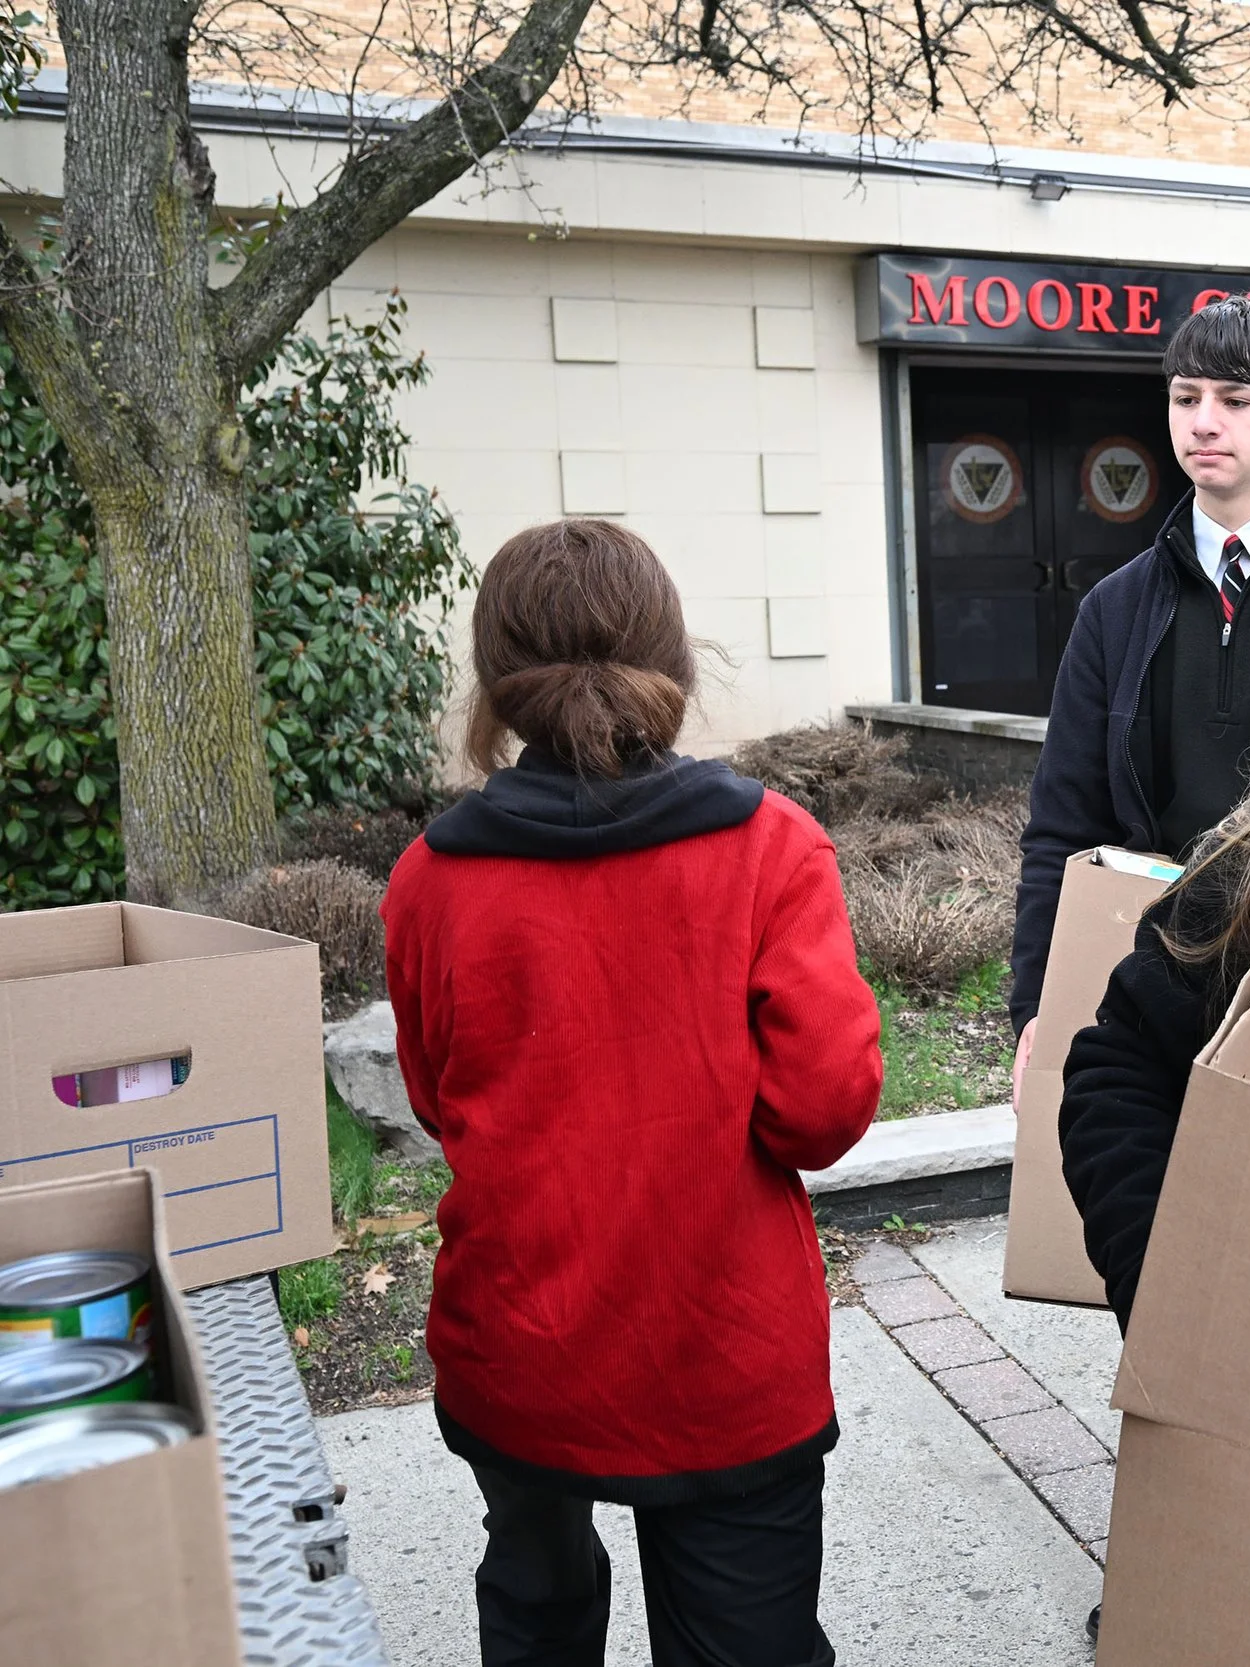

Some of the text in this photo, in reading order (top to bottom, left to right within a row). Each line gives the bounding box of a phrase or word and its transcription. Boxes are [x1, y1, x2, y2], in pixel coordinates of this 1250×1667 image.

[905, 272, 1162, 336] MOORE
[134, 1131, 215, 1154] DESTROY DATE
